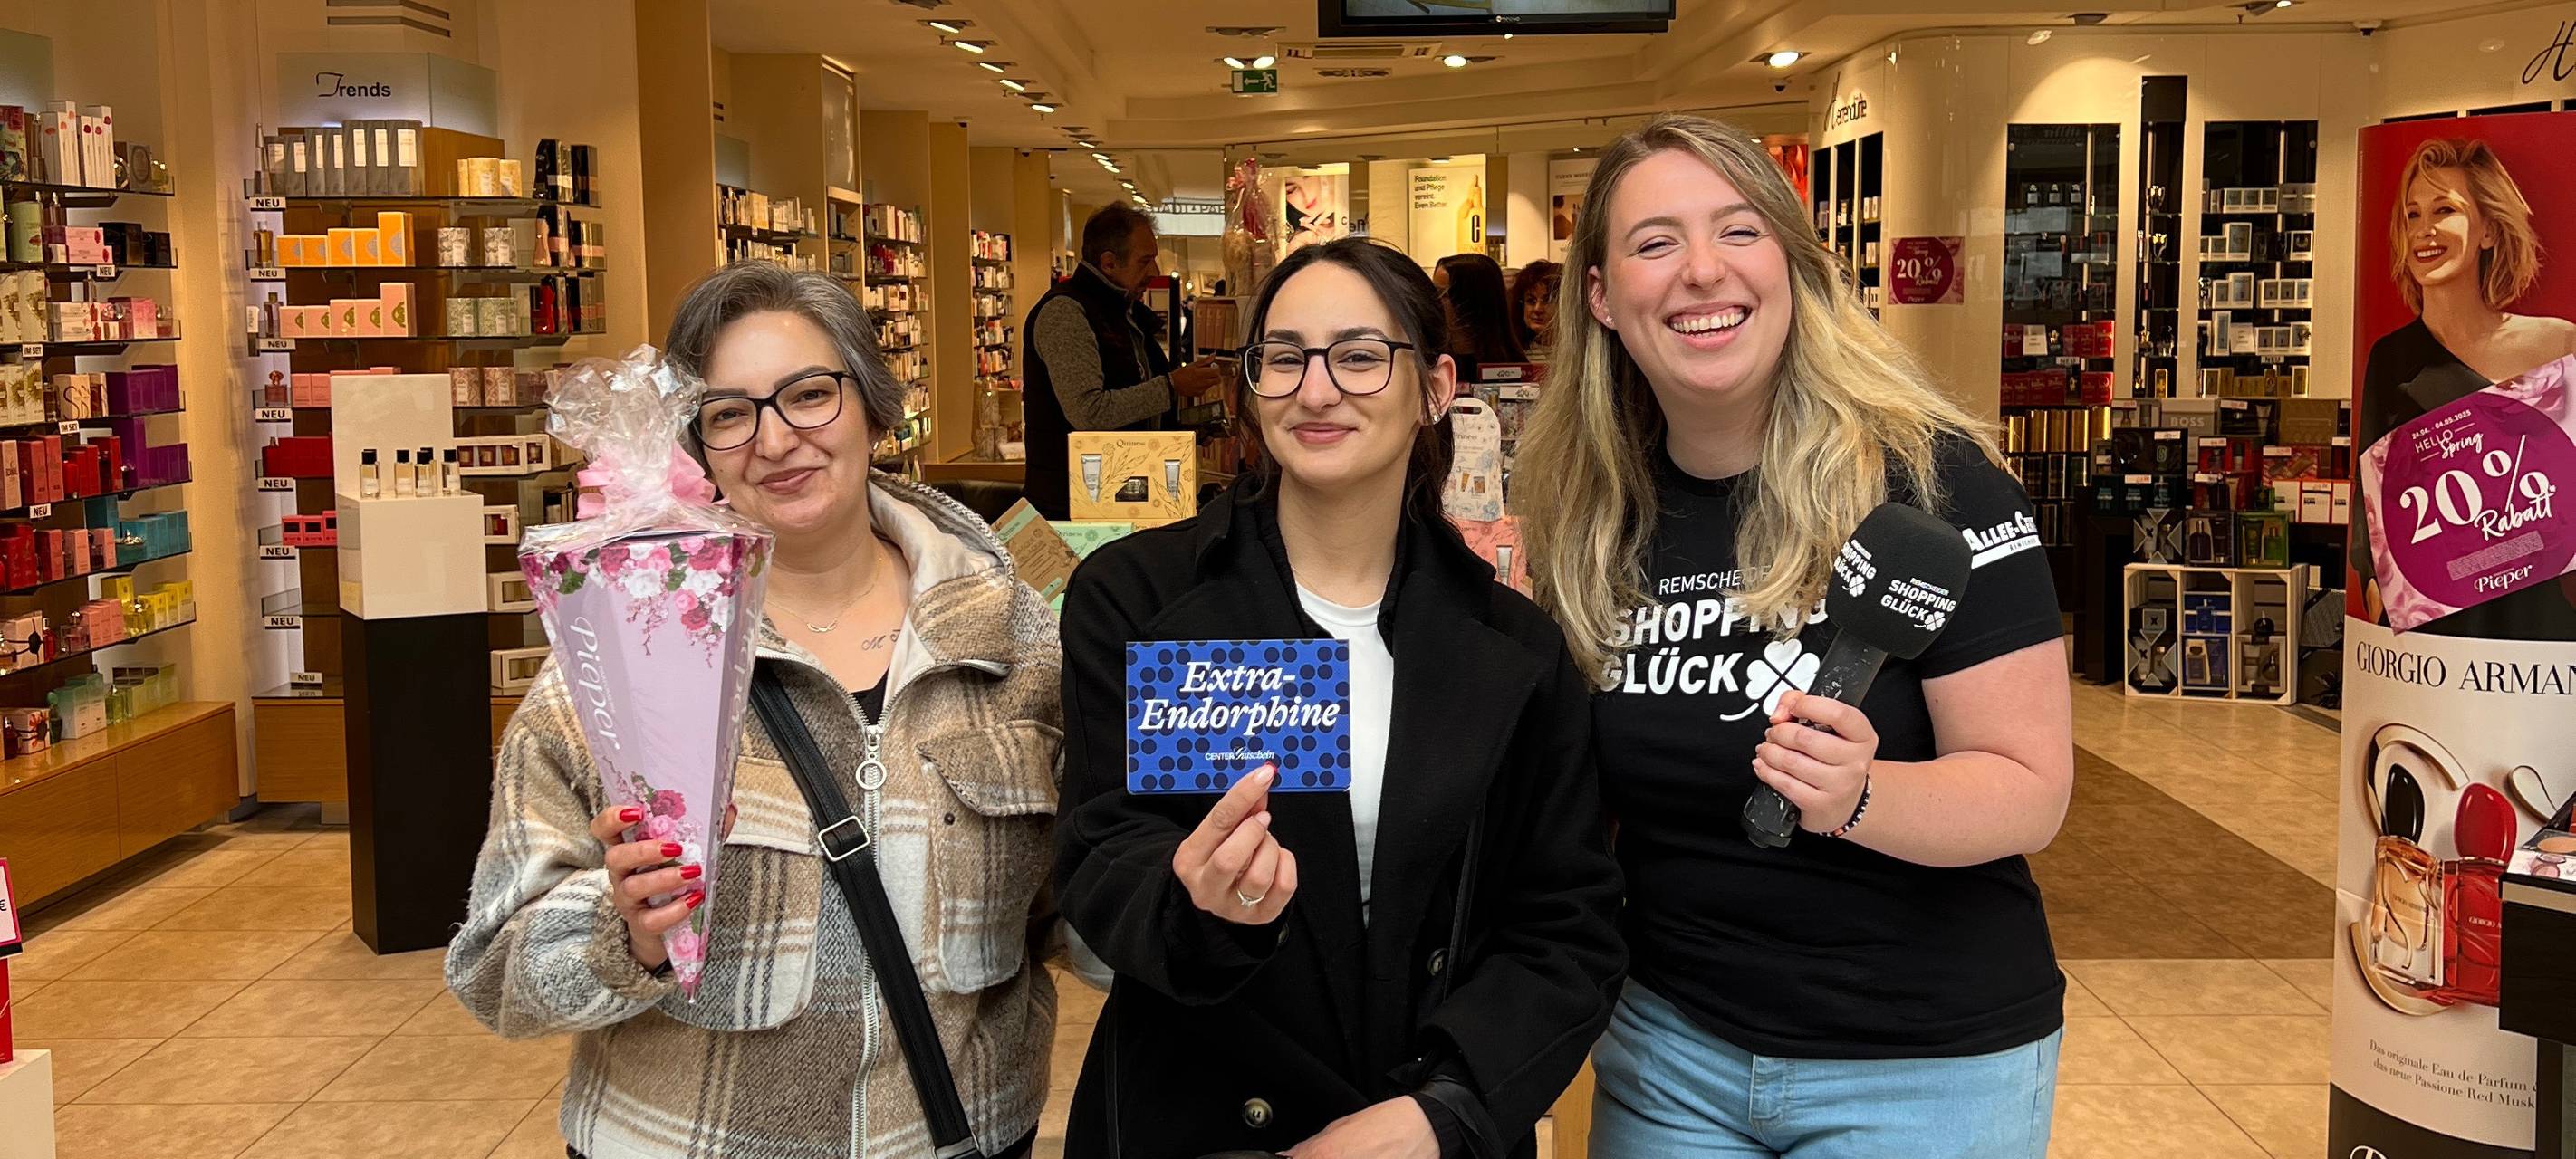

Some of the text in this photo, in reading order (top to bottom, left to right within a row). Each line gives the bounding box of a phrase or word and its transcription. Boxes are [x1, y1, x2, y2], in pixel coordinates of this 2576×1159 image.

[316, 72, 391, 98] Trends
[255, 198, 280, 207] NEU
[99, 267, 112, 275] NEU
[1897, 256, 1942, 280] 20%
[32, 345, 42, 355] SET
[261, 410, 285, 418] NEU
[69, 423, 78, 432] SET
[2415, 429, 2453, 453] HELLO
[2440, 432, 2484, 459] Spring
[264, 479, 288, 488] NEU
[33, 507, 48, 516] NEU
[265, 547, 290, 555] NEU
[2474, 564, 2533, 593] Pieper
[1880, 594, 1929, 621] GLÜCK
[1888, 579, 1956, 612] SHOPPING
[271, 618, 294, 626] NEU
[1600, 647, 1744, 695] GLÜCK
[2357, 641, 2446, 688] GIORGIO
[297, 674, 315, 682] NEU
[570, 616, 620, 750] Pieper
[1179, 661, 1296, 694] Extra-
[1138, 696, 1341, 736] Endorphine
[2369, 1039, 2386, 1056] Das
[2387, 1049, 2429, 1072] originale
[2432, 1062, 2455, 1078] Eau
[2457, 1069, 2475, 1083] de
[2478, 1073, 2528, 1091] Parfum
[2373, 1057, 2536, 1109] das neue Passione Red Musk
